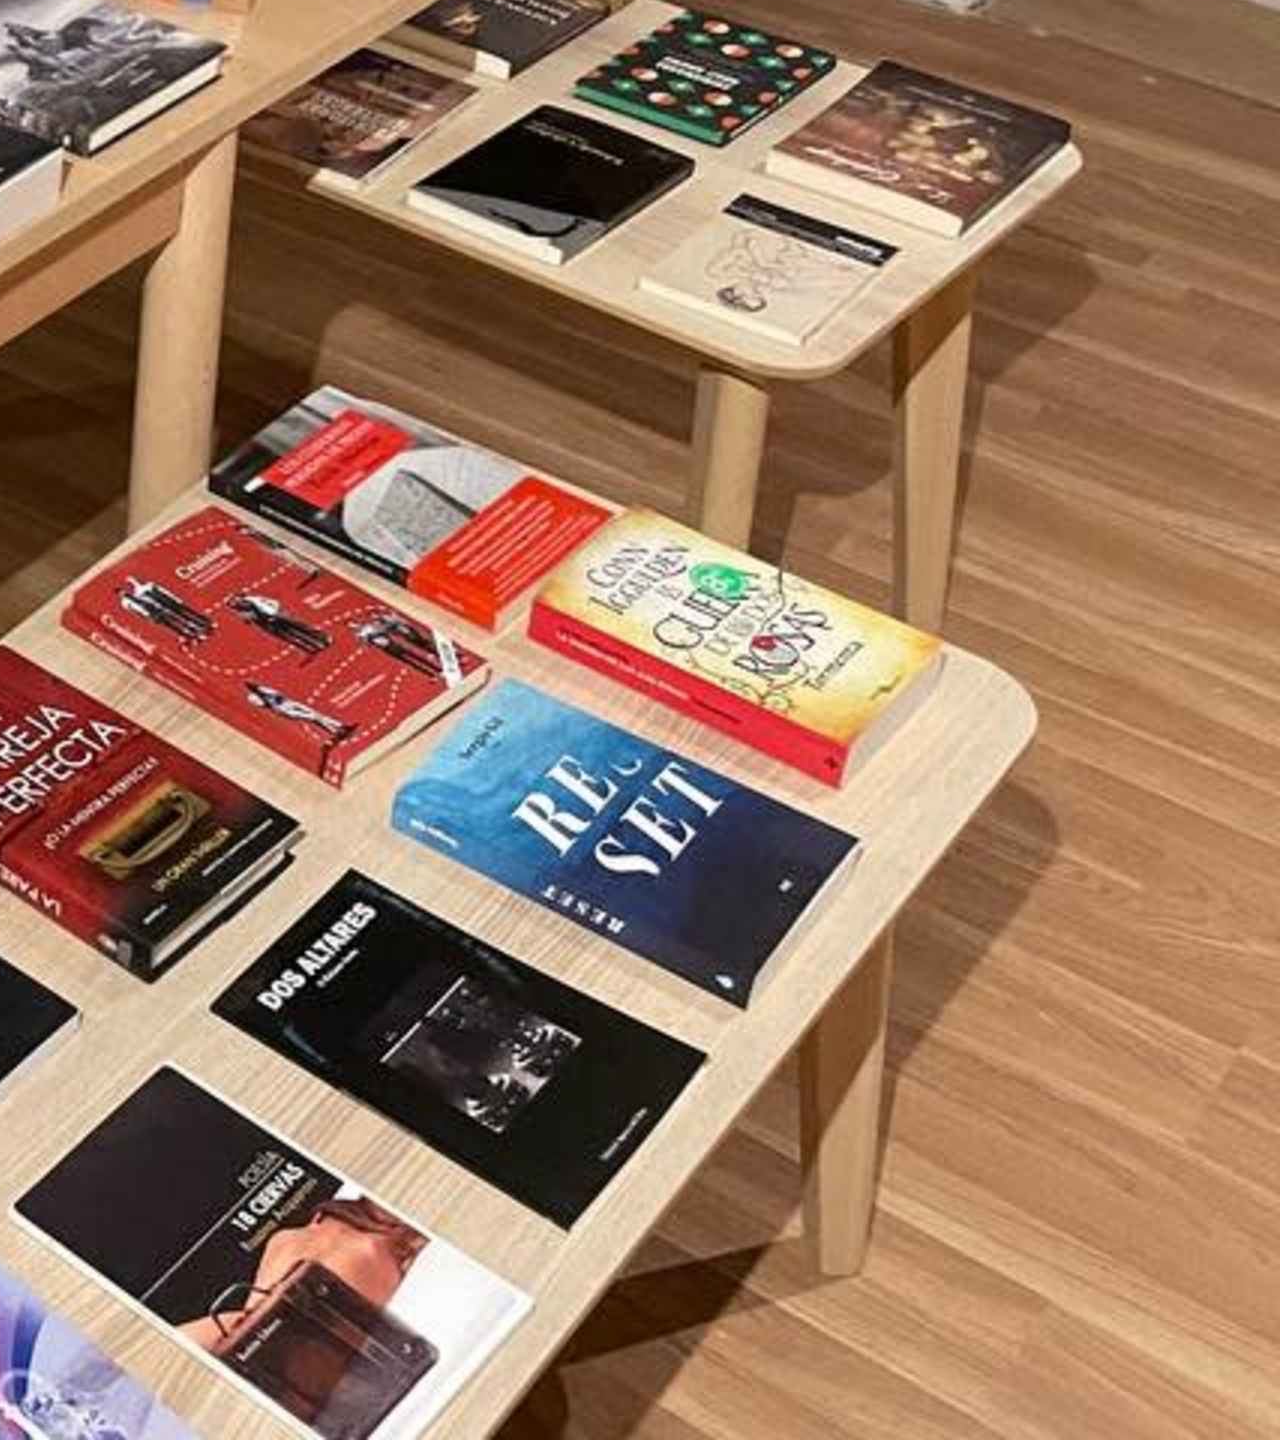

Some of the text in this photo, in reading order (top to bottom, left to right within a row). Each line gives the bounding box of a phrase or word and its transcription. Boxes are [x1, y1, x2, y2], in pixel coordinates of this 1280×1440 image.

[593, 761, 725, 879] SET
[256, 899, 378, 1014] DOS ALTARES
[543, 883, 628, 937] RESET
[230, 1203, 258, 1232] 18
[248, 1160, 306, 1219] CIERVAS
